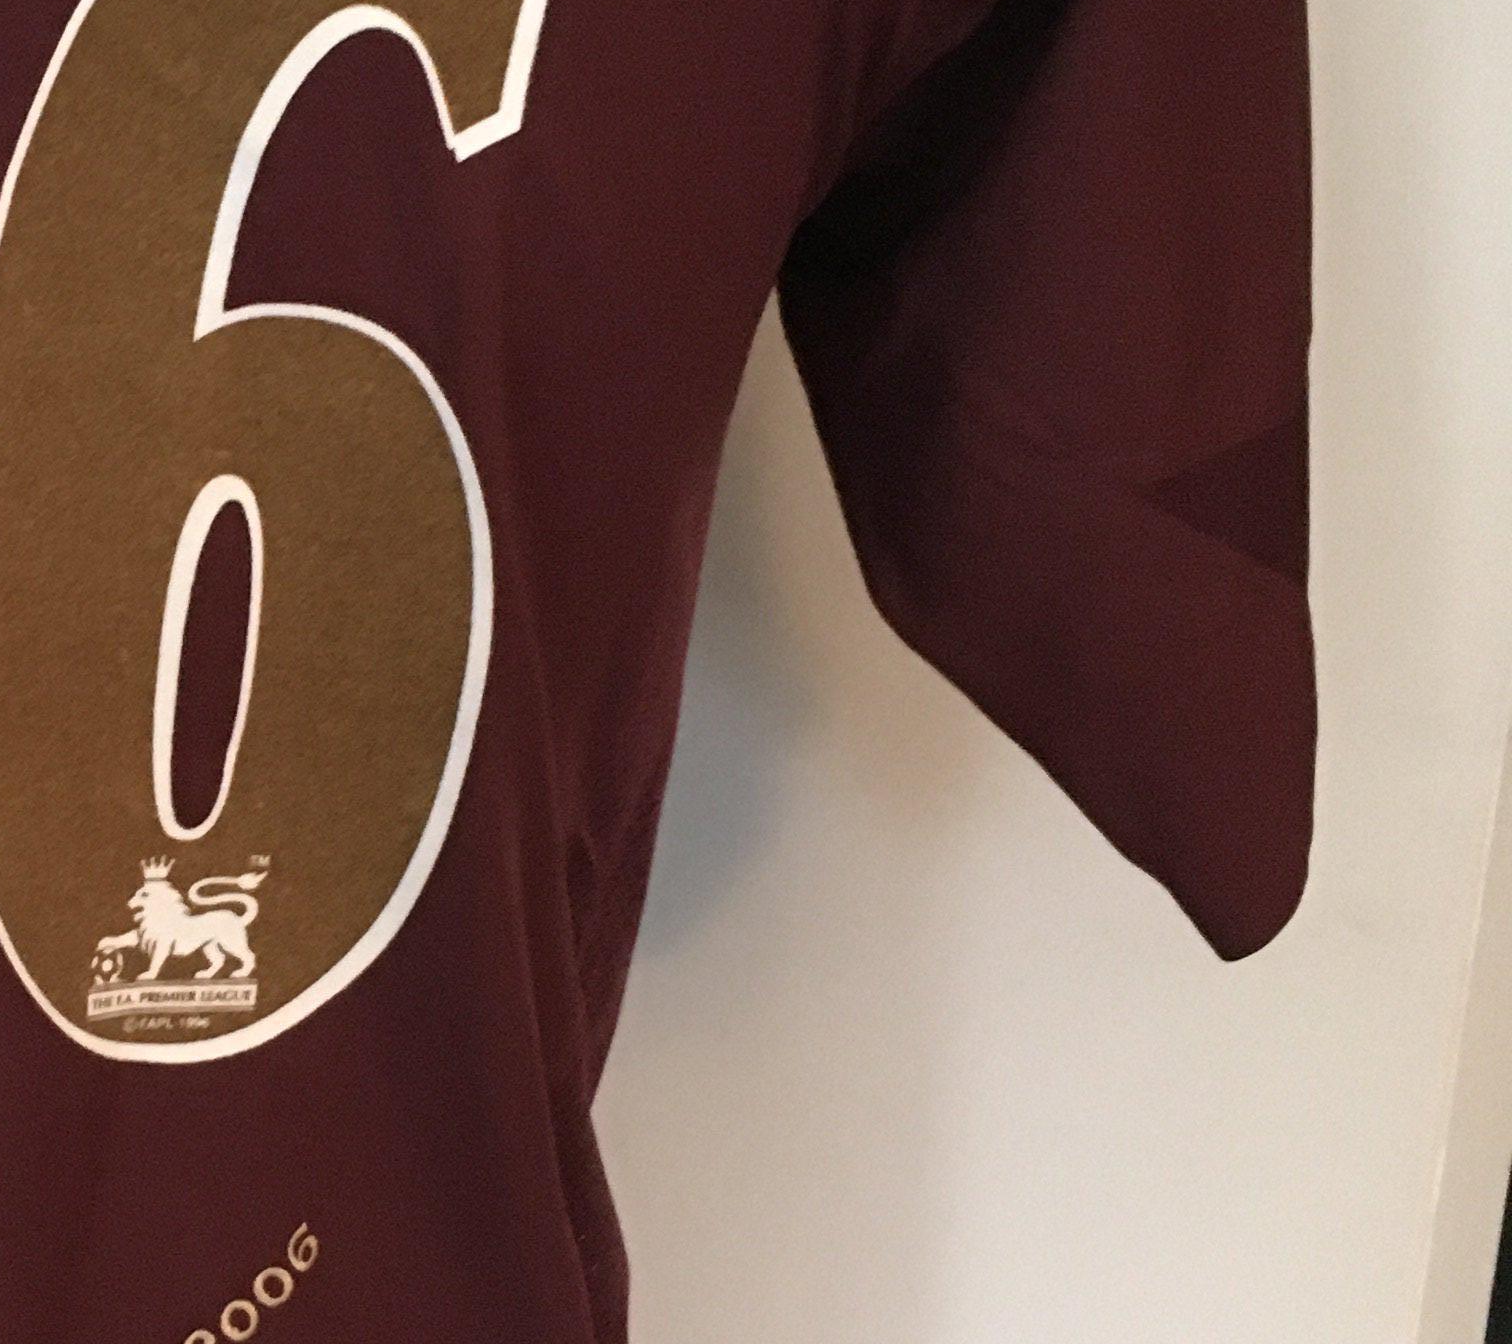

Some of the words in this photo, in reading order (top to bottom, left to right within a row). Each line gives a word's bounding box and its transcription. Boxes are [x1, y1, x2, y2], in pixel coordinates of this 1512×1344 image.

[93, 996, 113, 1009] THE
[139, 990, 196, 1003] PREMIER
[200, 989, 251, 1002] LEAGUE
